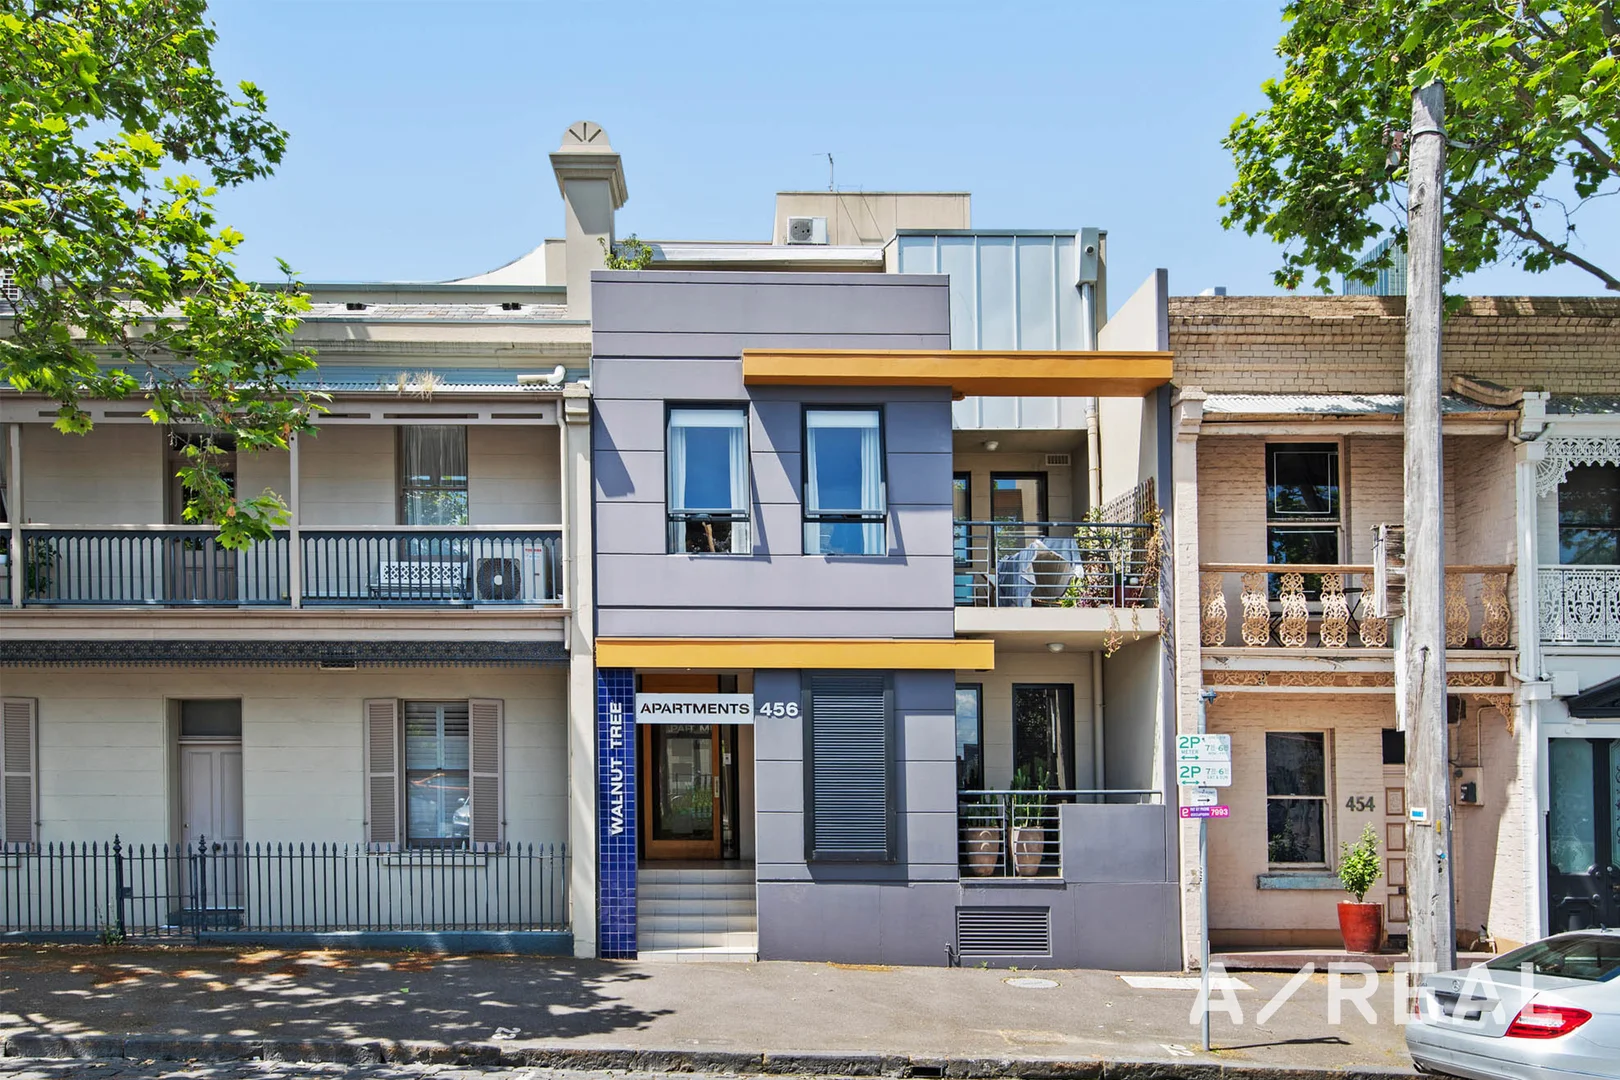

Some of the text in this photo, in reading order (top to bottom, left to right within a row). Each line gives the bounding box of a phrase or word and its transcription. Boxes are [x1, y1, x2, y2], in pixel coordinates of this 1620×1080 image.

[640, 702, 799, 717] APARTMENTS 456
[1179, 736, 1201, 748] 2P
[609, 701, 624, 836] WALNUT TREE
[1180, 766, 1201, 778] 2P
[1345, 796, 1376, 812] 454
